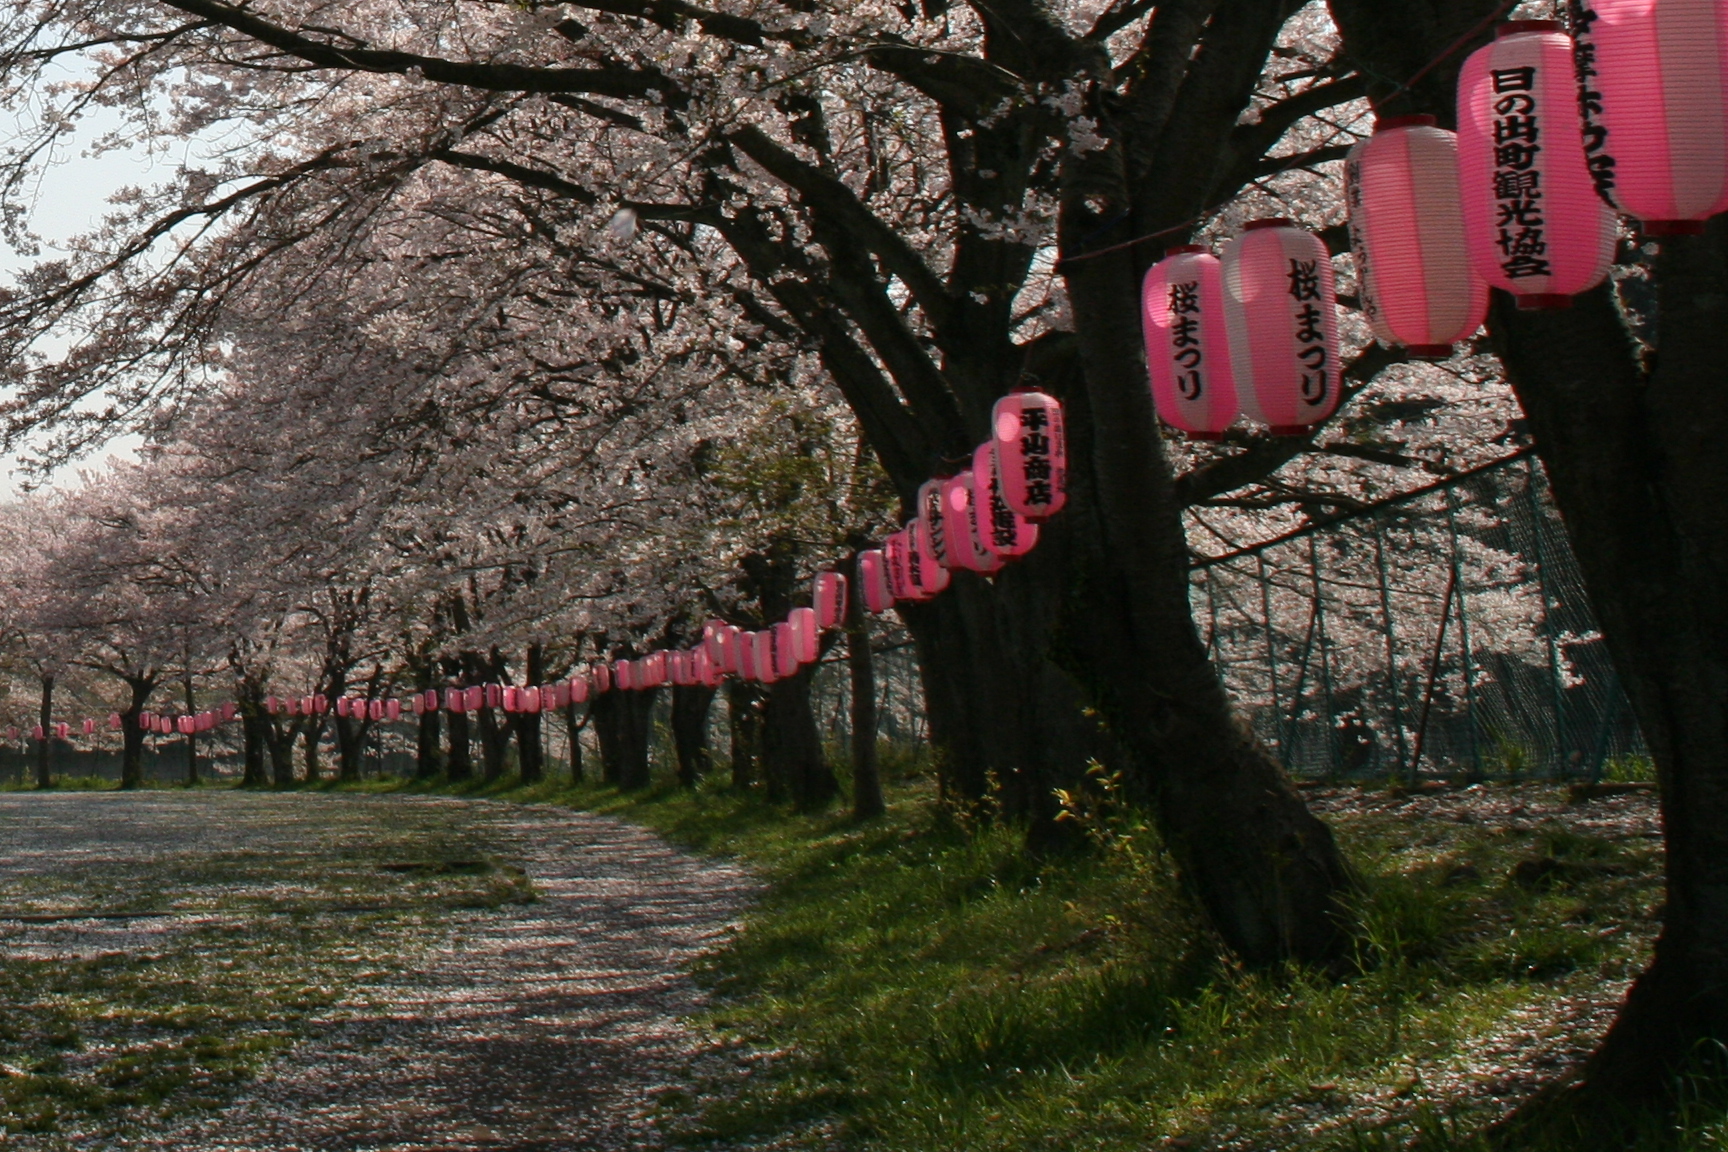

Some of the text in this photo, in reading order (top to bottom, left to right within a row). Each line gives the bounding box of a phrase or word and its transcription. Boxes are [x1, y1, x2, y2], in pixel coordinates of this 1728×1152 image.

[1491, 67, 1550, 279] 日の出町観光協会
[1168, 282, 1202, 401] 桜まつり
[1288, 258, 1327, 405] 桜まつり
